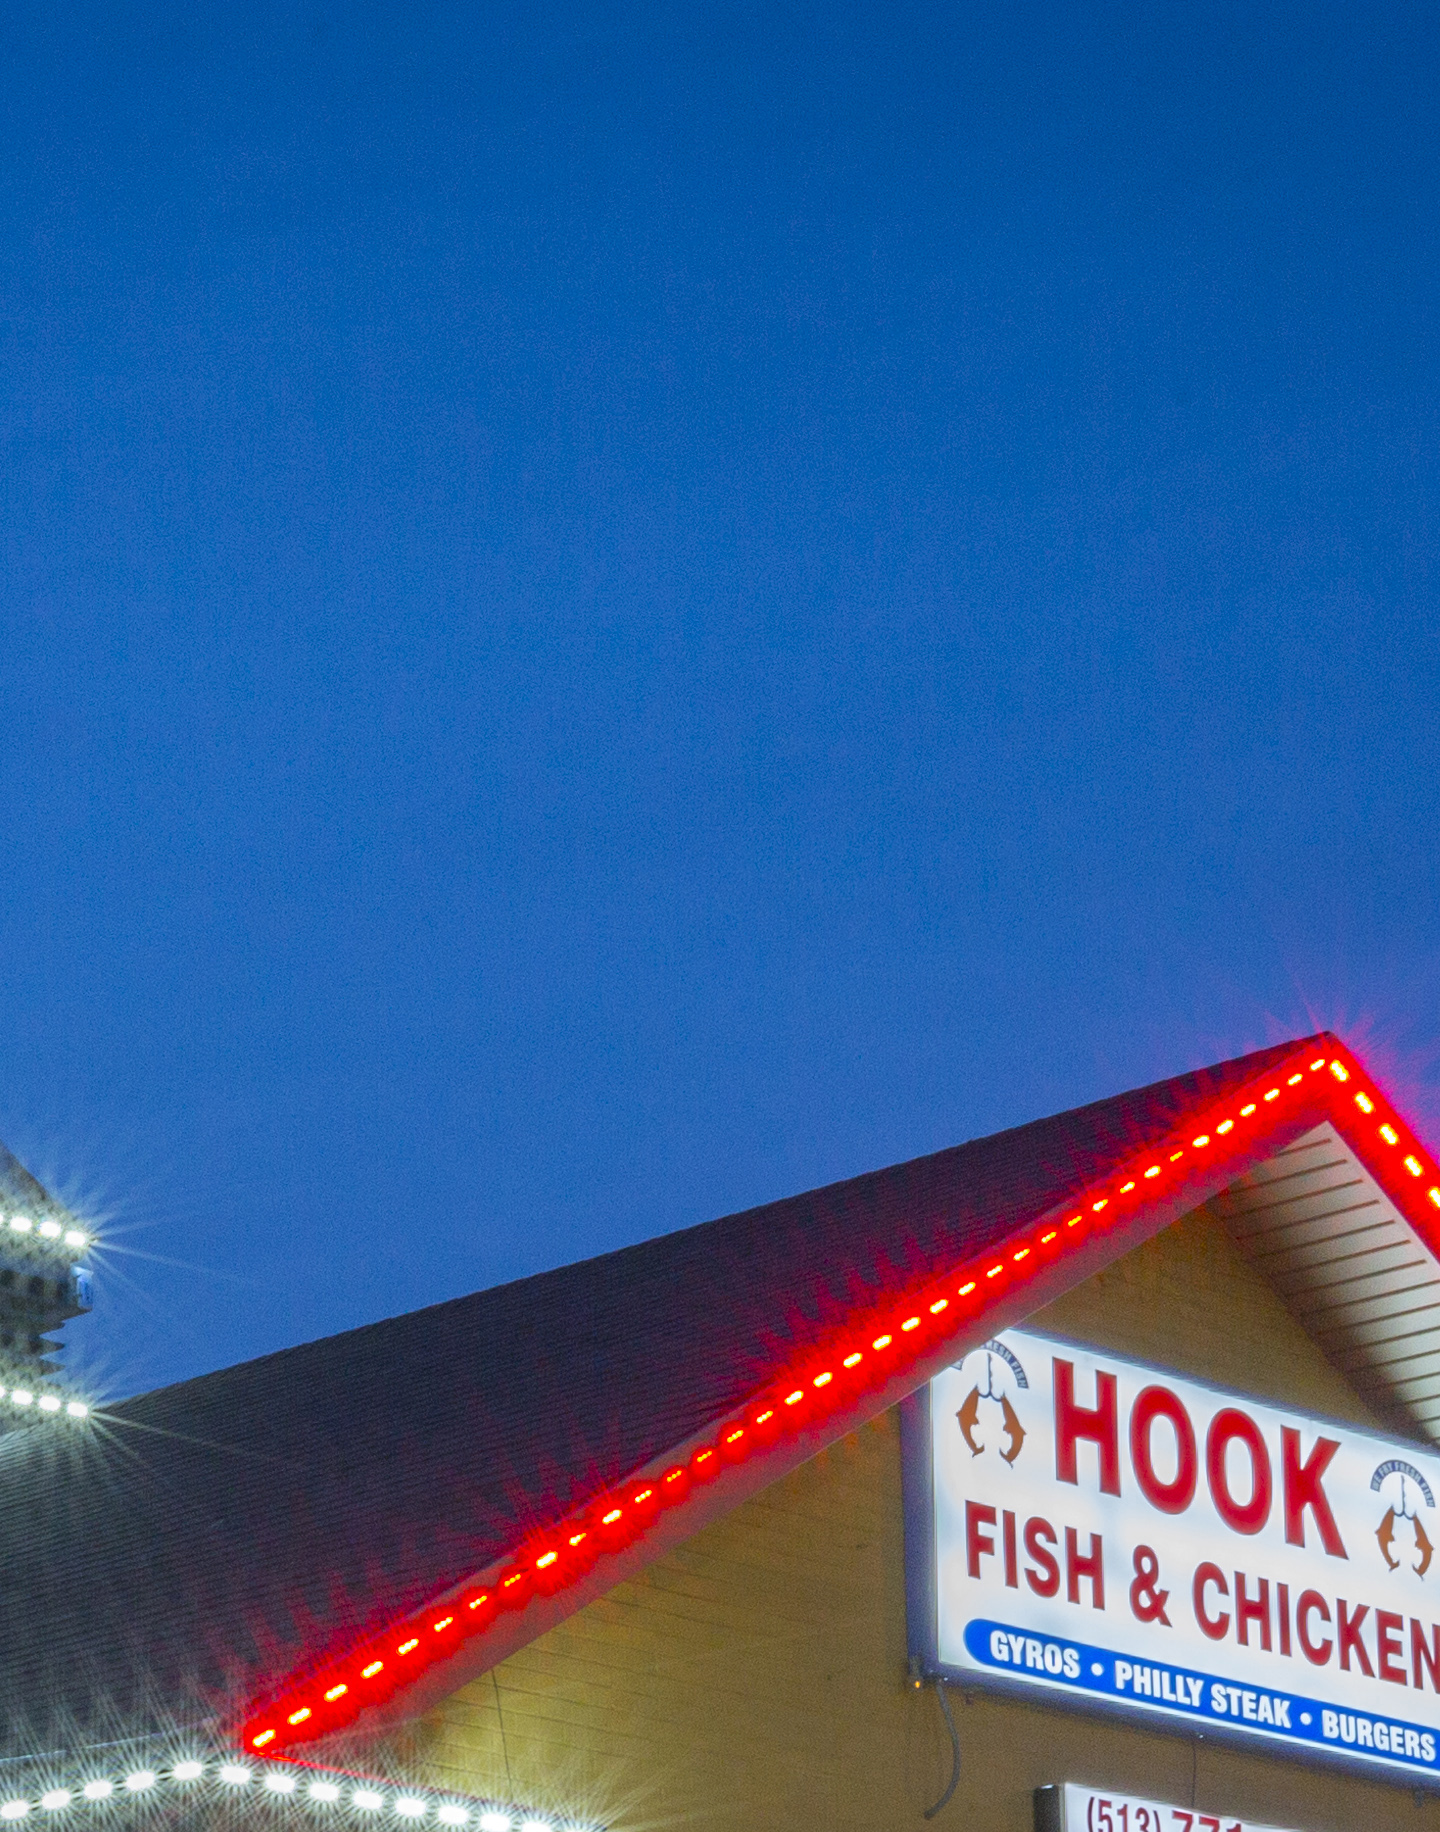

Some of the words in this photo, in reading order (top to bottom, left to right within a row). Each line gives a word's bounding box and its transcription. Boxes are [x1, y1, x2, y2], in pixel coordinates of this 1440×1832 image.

[1011, 1361, 1028, 1388] FISH
[1051, 1357, 1349, 1560] HOOK
[1394, 1461, 1422, 1483] FRESH
[1420, 1482, 1435, 1507] FISH
[964, 1499, 1106, 1611] FISH
[1128, 1544, 1173, 1629] &
[989, 1629, 1081, 1679] GYROS
[1114, 1660, 1203, 1709] PHILLY
[1210, 1684, 1291, 1729] STEAK
[1321, 1709, 1437, 1763] BURGERS
